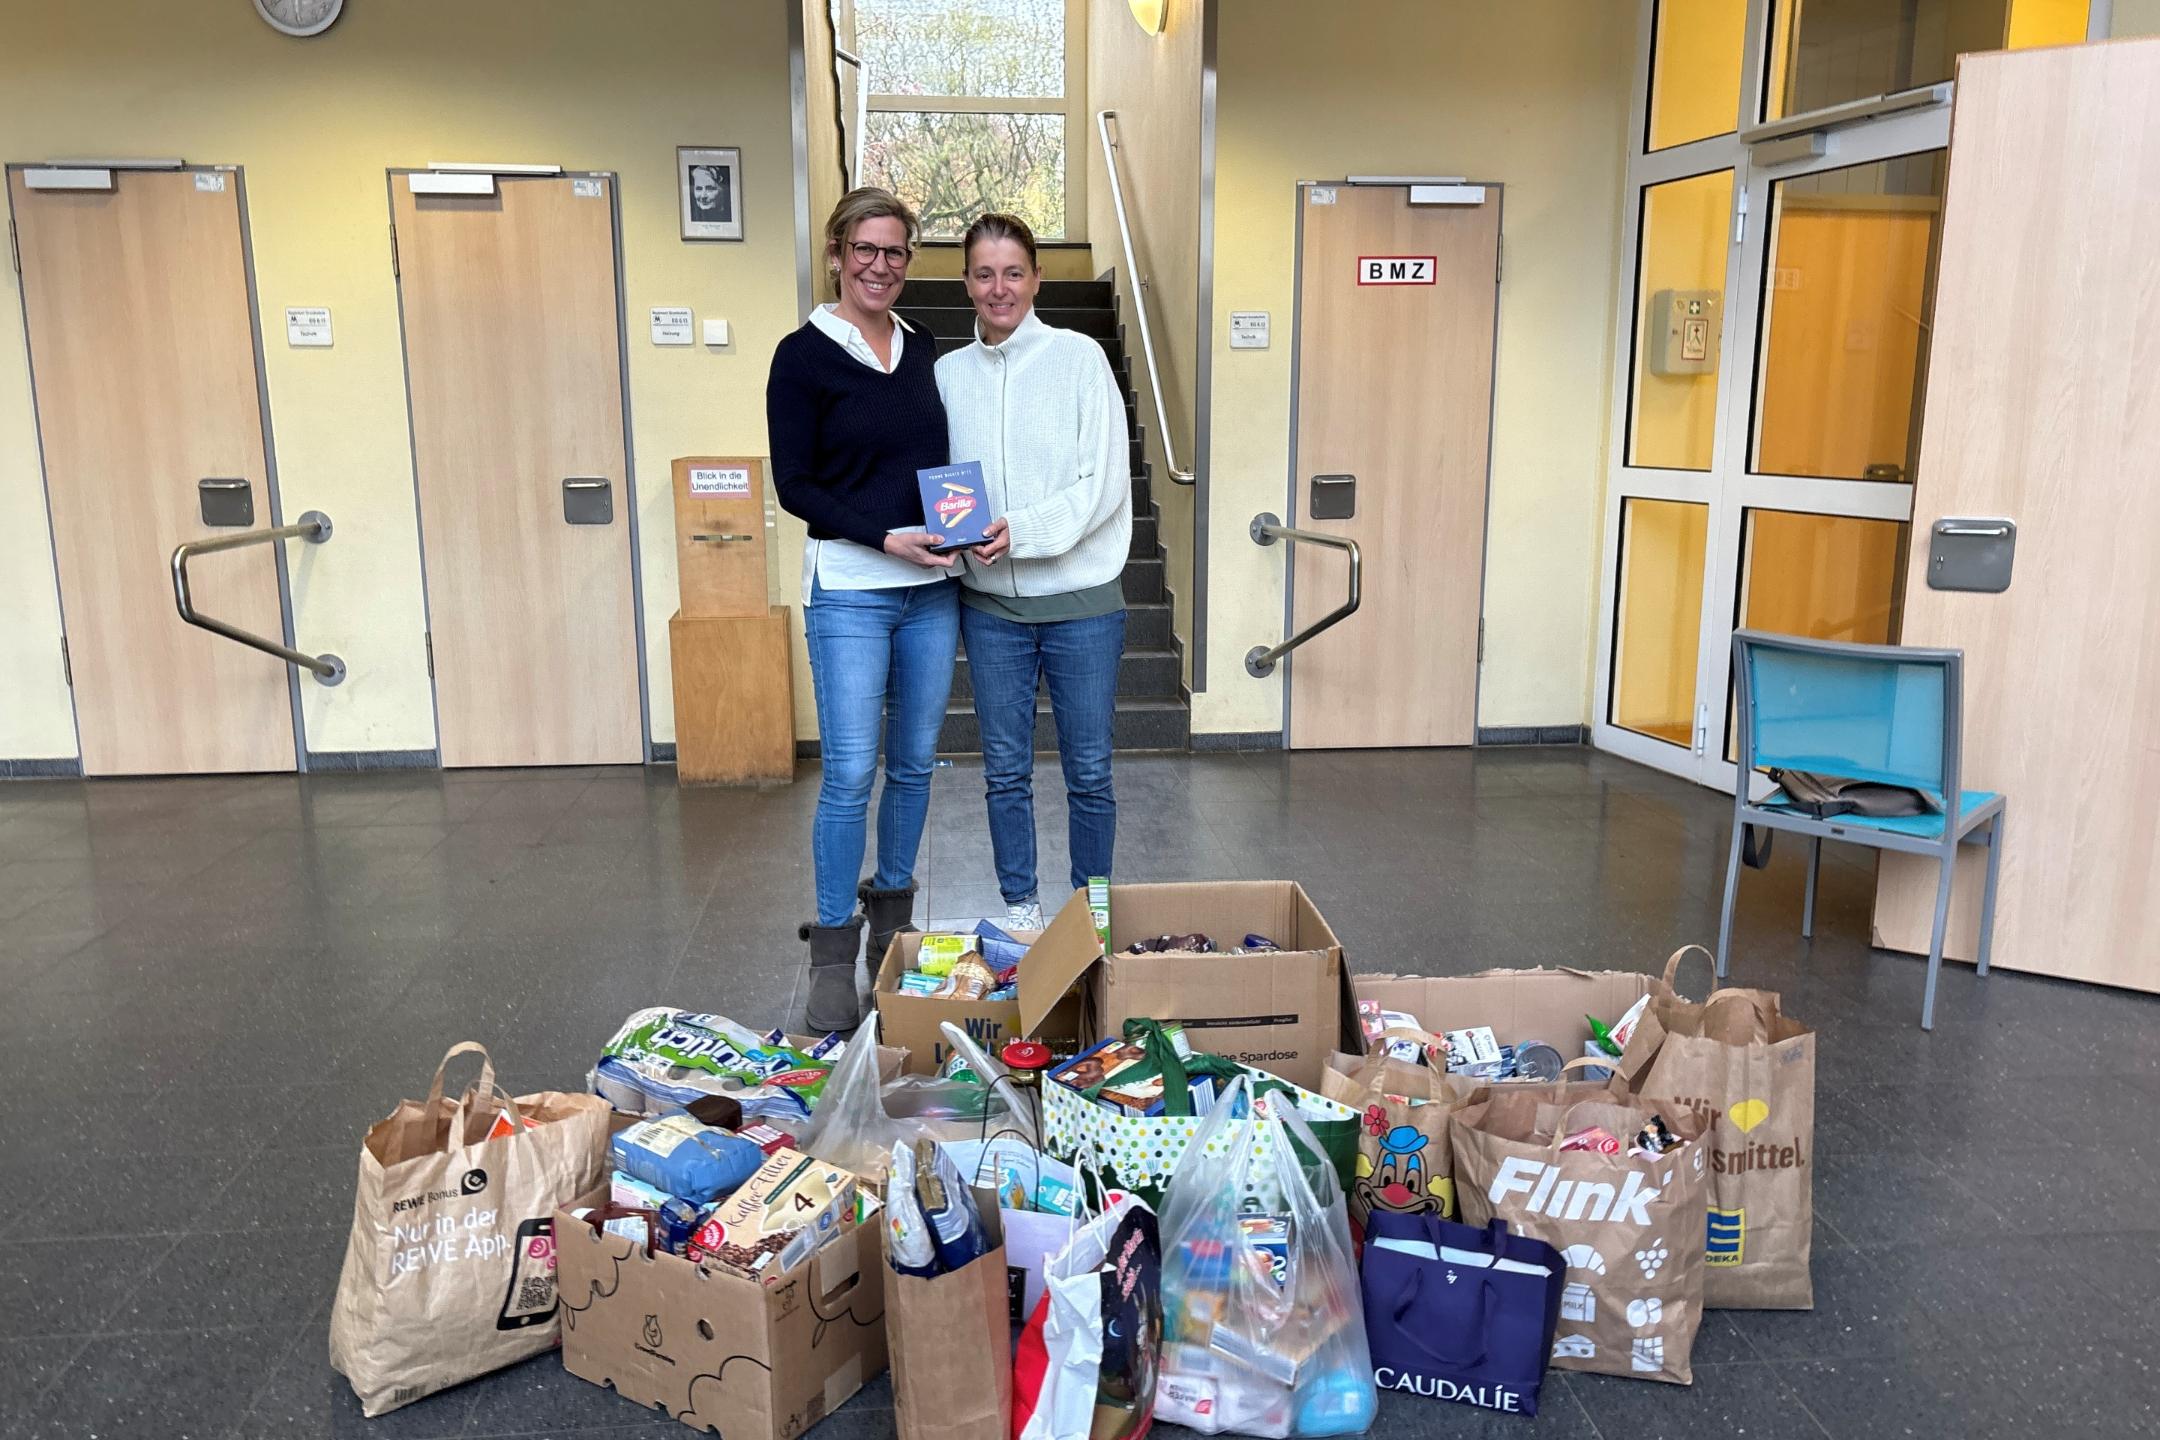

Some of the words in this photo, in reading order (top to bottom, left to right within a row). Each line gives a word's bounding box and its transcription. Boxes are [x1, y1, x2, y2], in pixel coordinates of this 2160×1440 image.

[691, 482, 749, 491] Unendlichkeit
[696, 471, 717, 480] Blick
[728, 471, 742, 480] die
[940, 498, 972, 512] Barilla
[964, 1017, 1002, 1040] Wir
[1217, 1050, 1238, 1061] ine
[1239, 1050, 1299, 1064] Spardose
[1706, 1136, 1805, 1175] smittel.
[392, 1195, 426, 1213] REWE
[427, 1188, 459, 1204] Bonus
[726, 1189, 764, 1228] Kaffee
[751, 1154, 793, 1190] Filter
[795, 1192, 816, 1213] 4
[1488, 1156, 1673, 1226] Flink
[393, 1222, 431, 1250] Nur
[435, 1212, 456, 1236] in
[464, 1206, 499, 1230] der
[391, 1238, 459, 1276] REWE
[464, 1233, 512, 1261] App.
[1705, 1254, 1739, 1263] DEKA
[1374, 1367, 1520, 1413] CAUDALÍE
